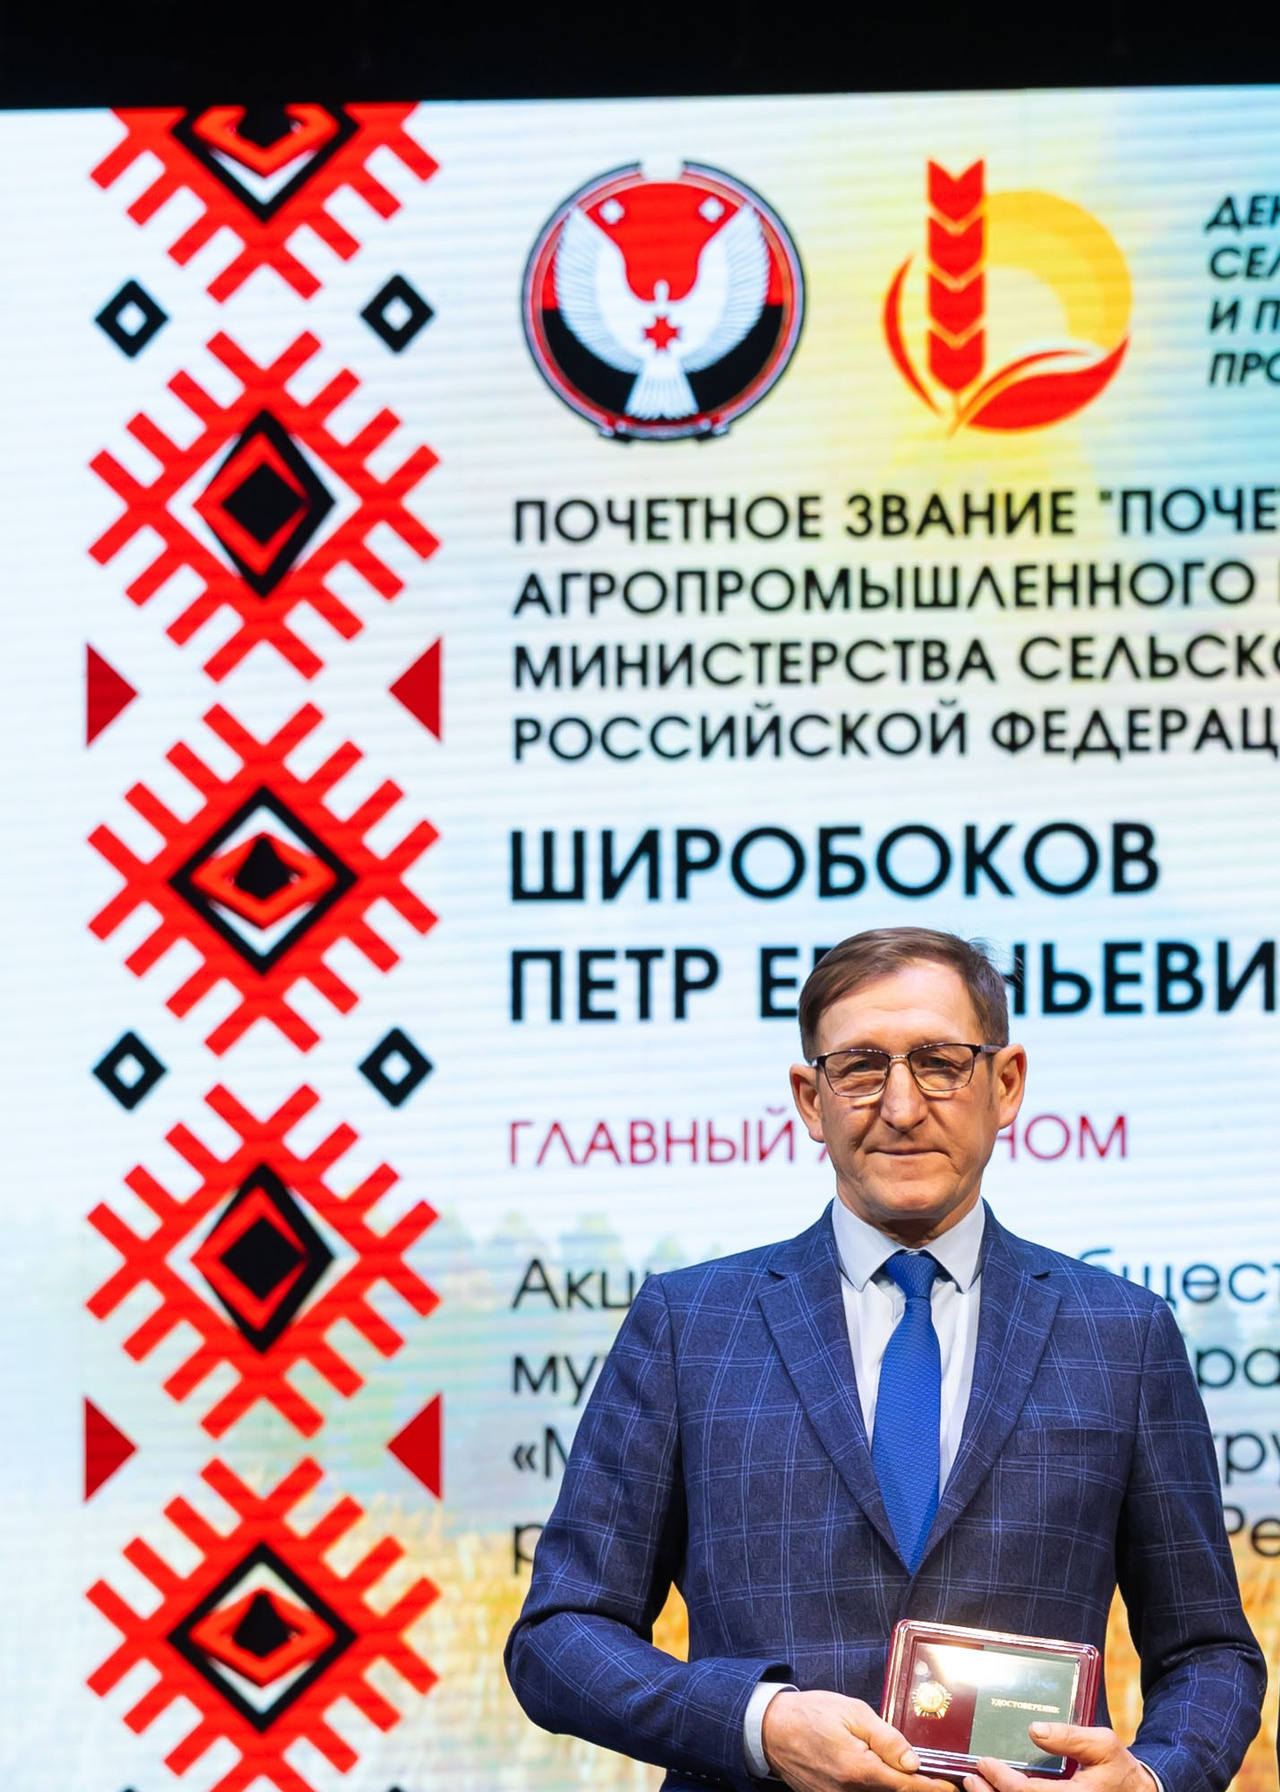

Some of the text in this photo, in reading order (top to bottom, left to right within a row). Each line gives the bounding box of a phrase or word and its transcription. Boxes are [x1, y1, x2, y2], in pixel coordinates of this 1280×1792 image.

[1208, 299, 1241, 333] И
[513, 494, 822, 544] ПОЧЕТНОЕ
[844, 489, 1075, 539] ЗВАНИЕ
[512, 559, 1257, 617] АГРОПРОМЫШЛЕННОГО
[513, 637, 997, 689] МИНИСТЕРСТВА
[513, 700, 967, 763] РОССИЙСКОЙ
[510, 821, 1160, 902] ШИРОБОКОВ
[510, 947, 721, 1022] ПЕТР
[509, 1104, 795, 1166] ГЛАВНЫЙ
